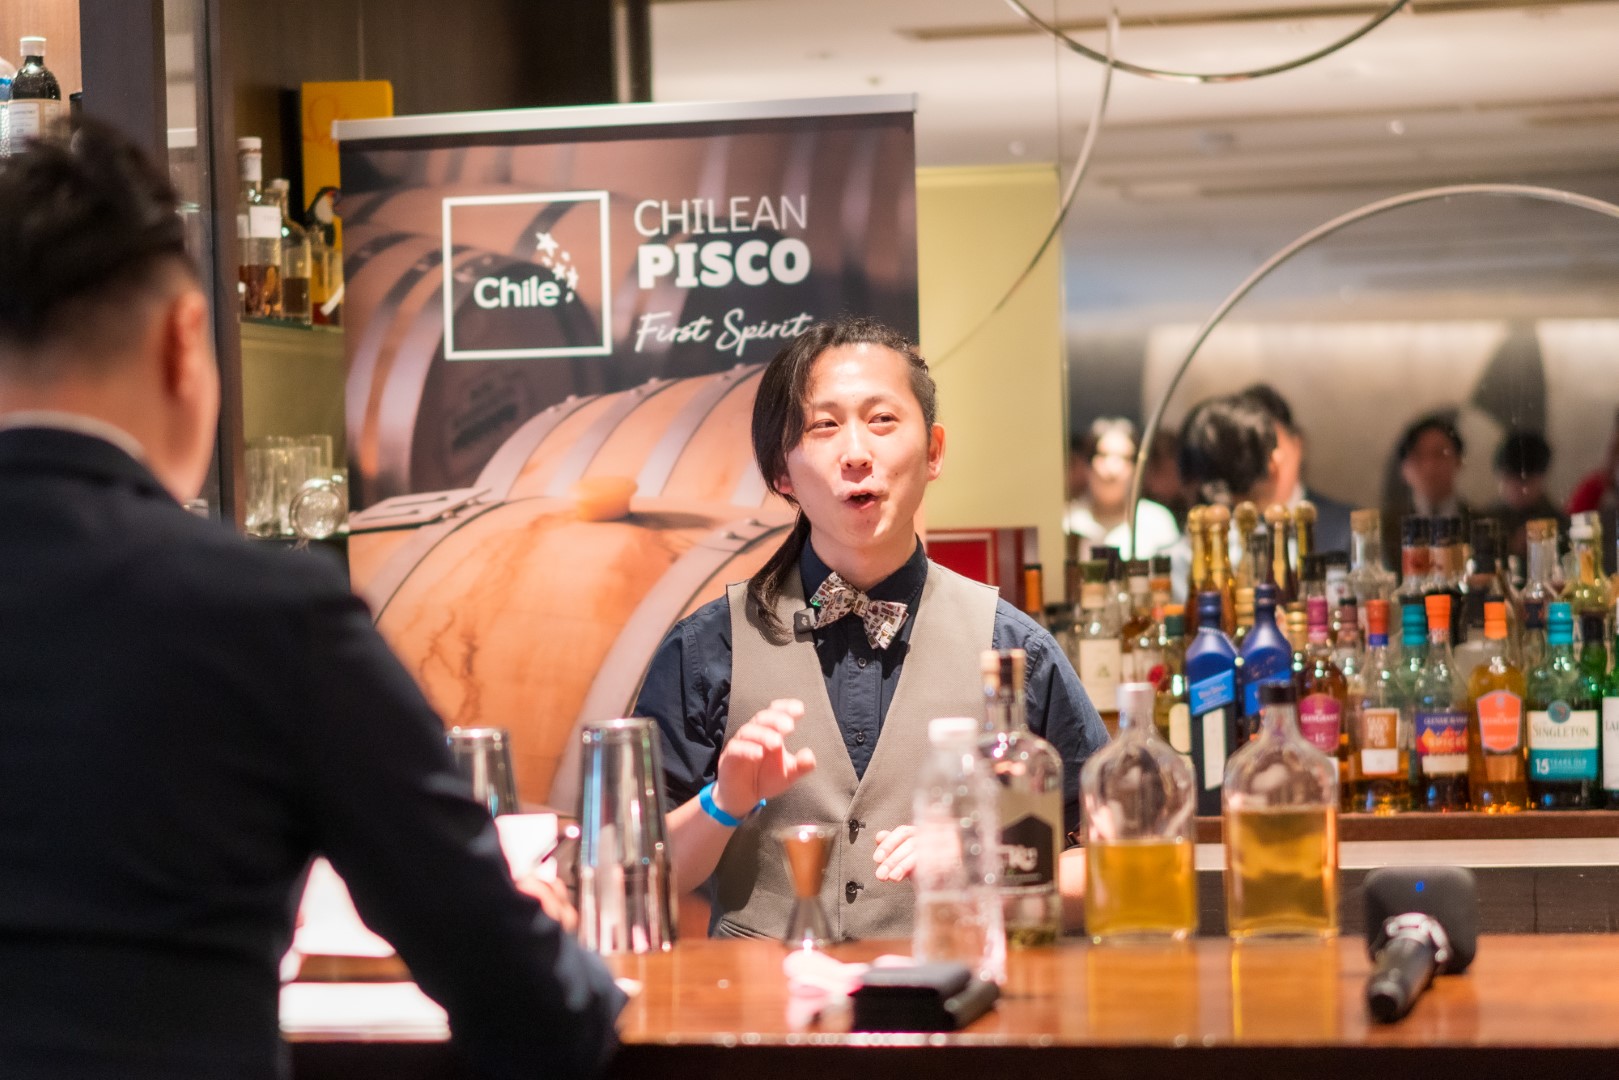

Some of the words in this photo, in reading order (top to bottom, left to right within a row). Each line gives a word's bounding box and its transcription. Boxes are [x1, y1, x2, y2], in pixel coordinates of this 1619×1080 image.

[634, 194, 808, 237] CHILEAN
[637, 238, 811, 289] PISCO
[474, 275, 560, 309] Chile
[634, 310, 714, 353] First
[715, 307, 814, 357] Spirit
[1533, 722, 1589, 738] SINGLETON
[1535, 757, 1550, 776] 15
